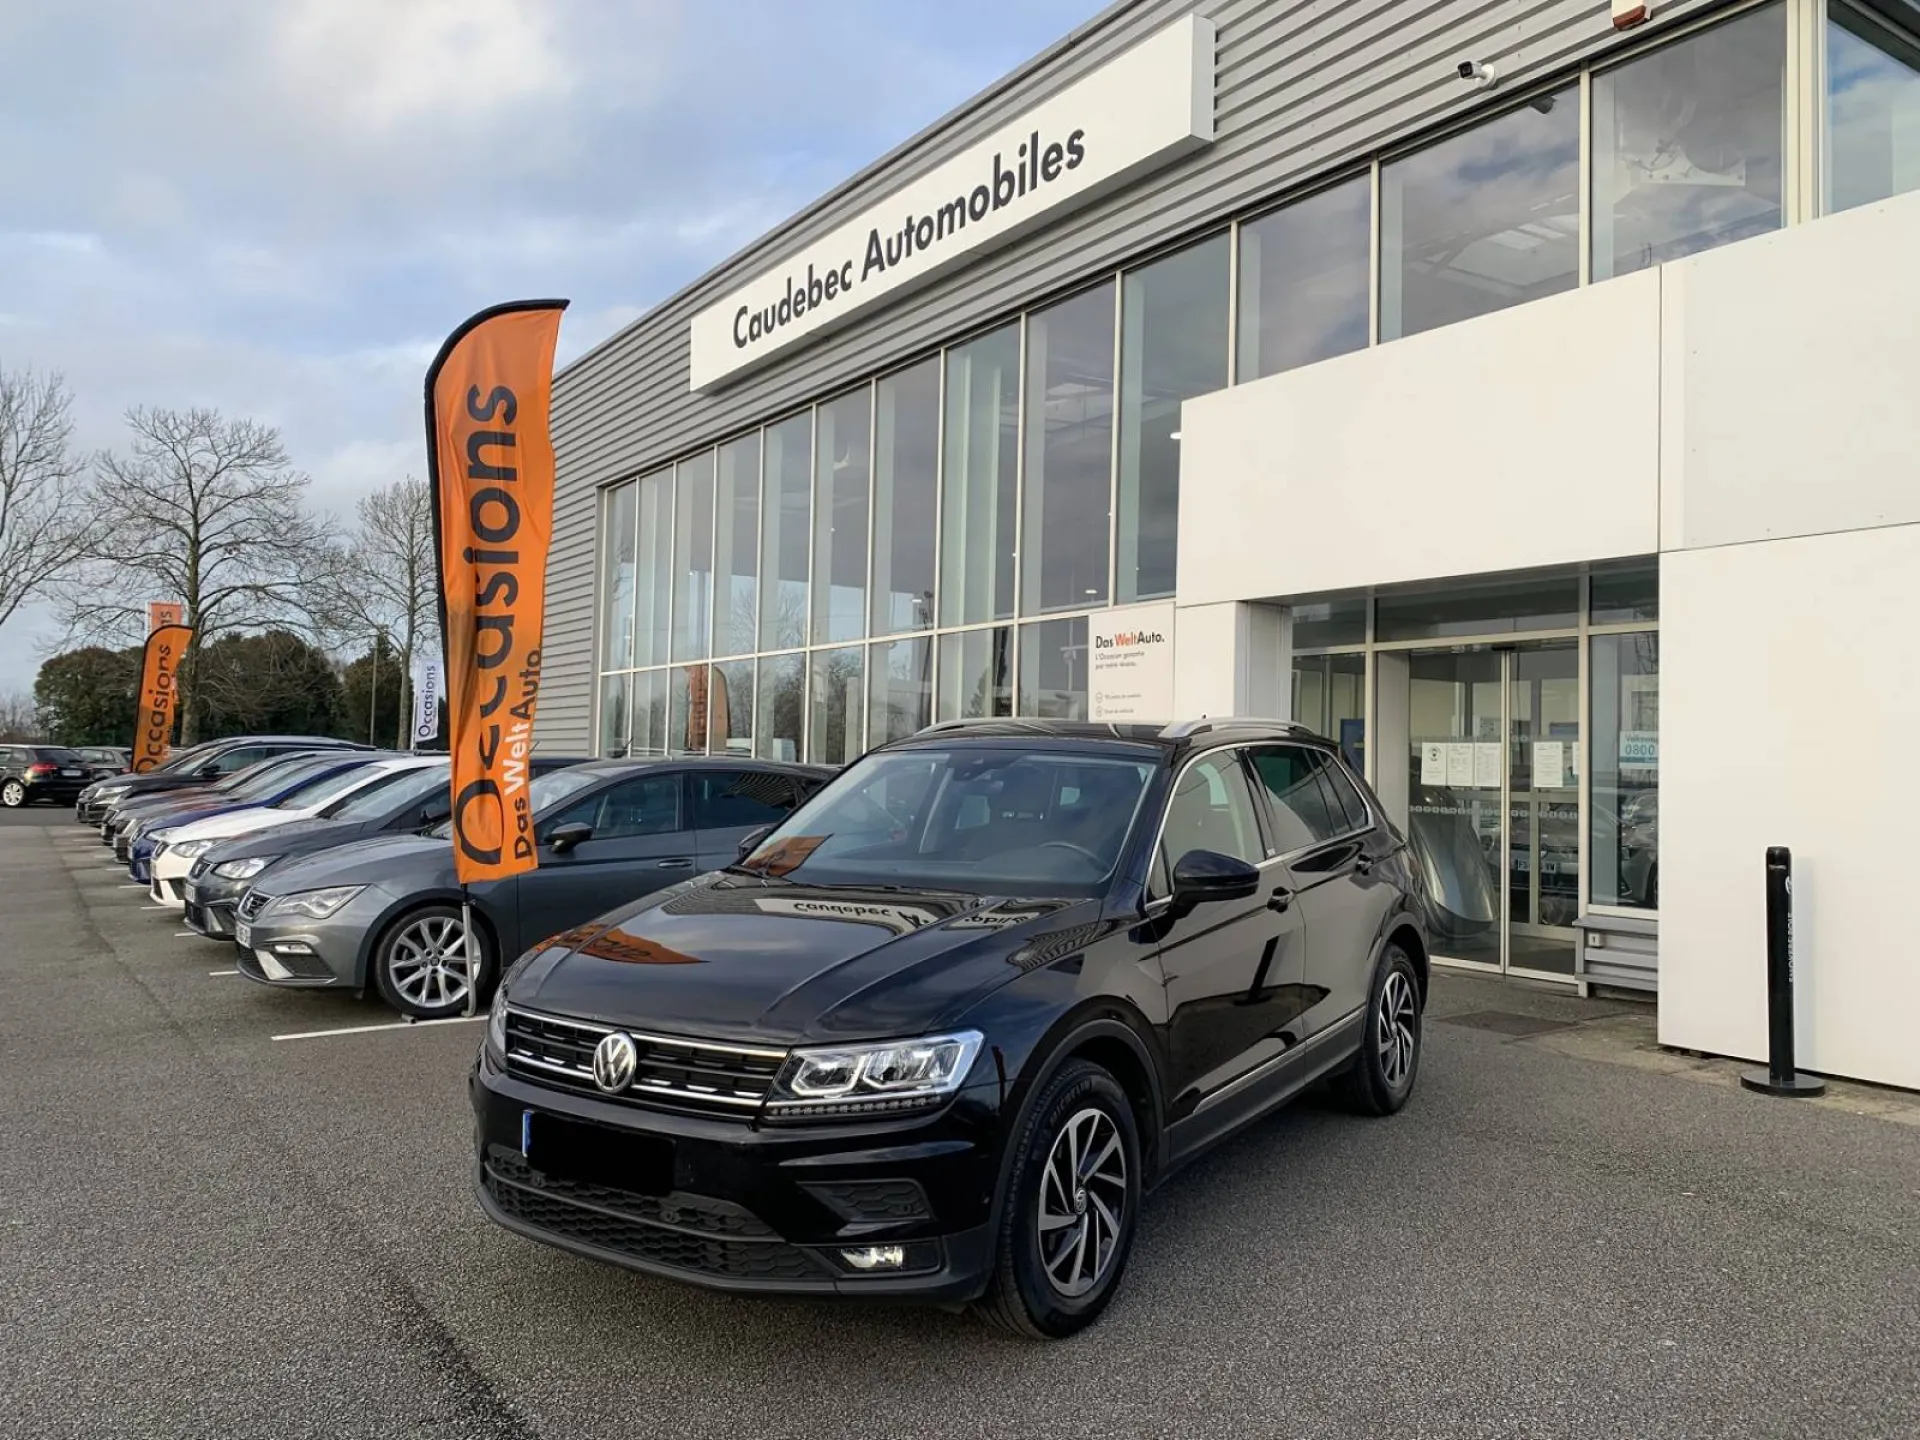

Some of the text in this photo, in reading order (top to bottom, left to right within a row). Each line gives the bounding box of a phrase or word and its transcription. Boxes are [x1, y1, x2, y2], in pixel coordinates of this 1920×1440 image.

[732, 129, 1085, 349] Caudebec Automobiles
[1096, 635, 1114, 649] Das
[418, 665, 436, 737] Occasions
[1625, 743, 1656, 756] 0800
[514, 797, 533, 860] Das
